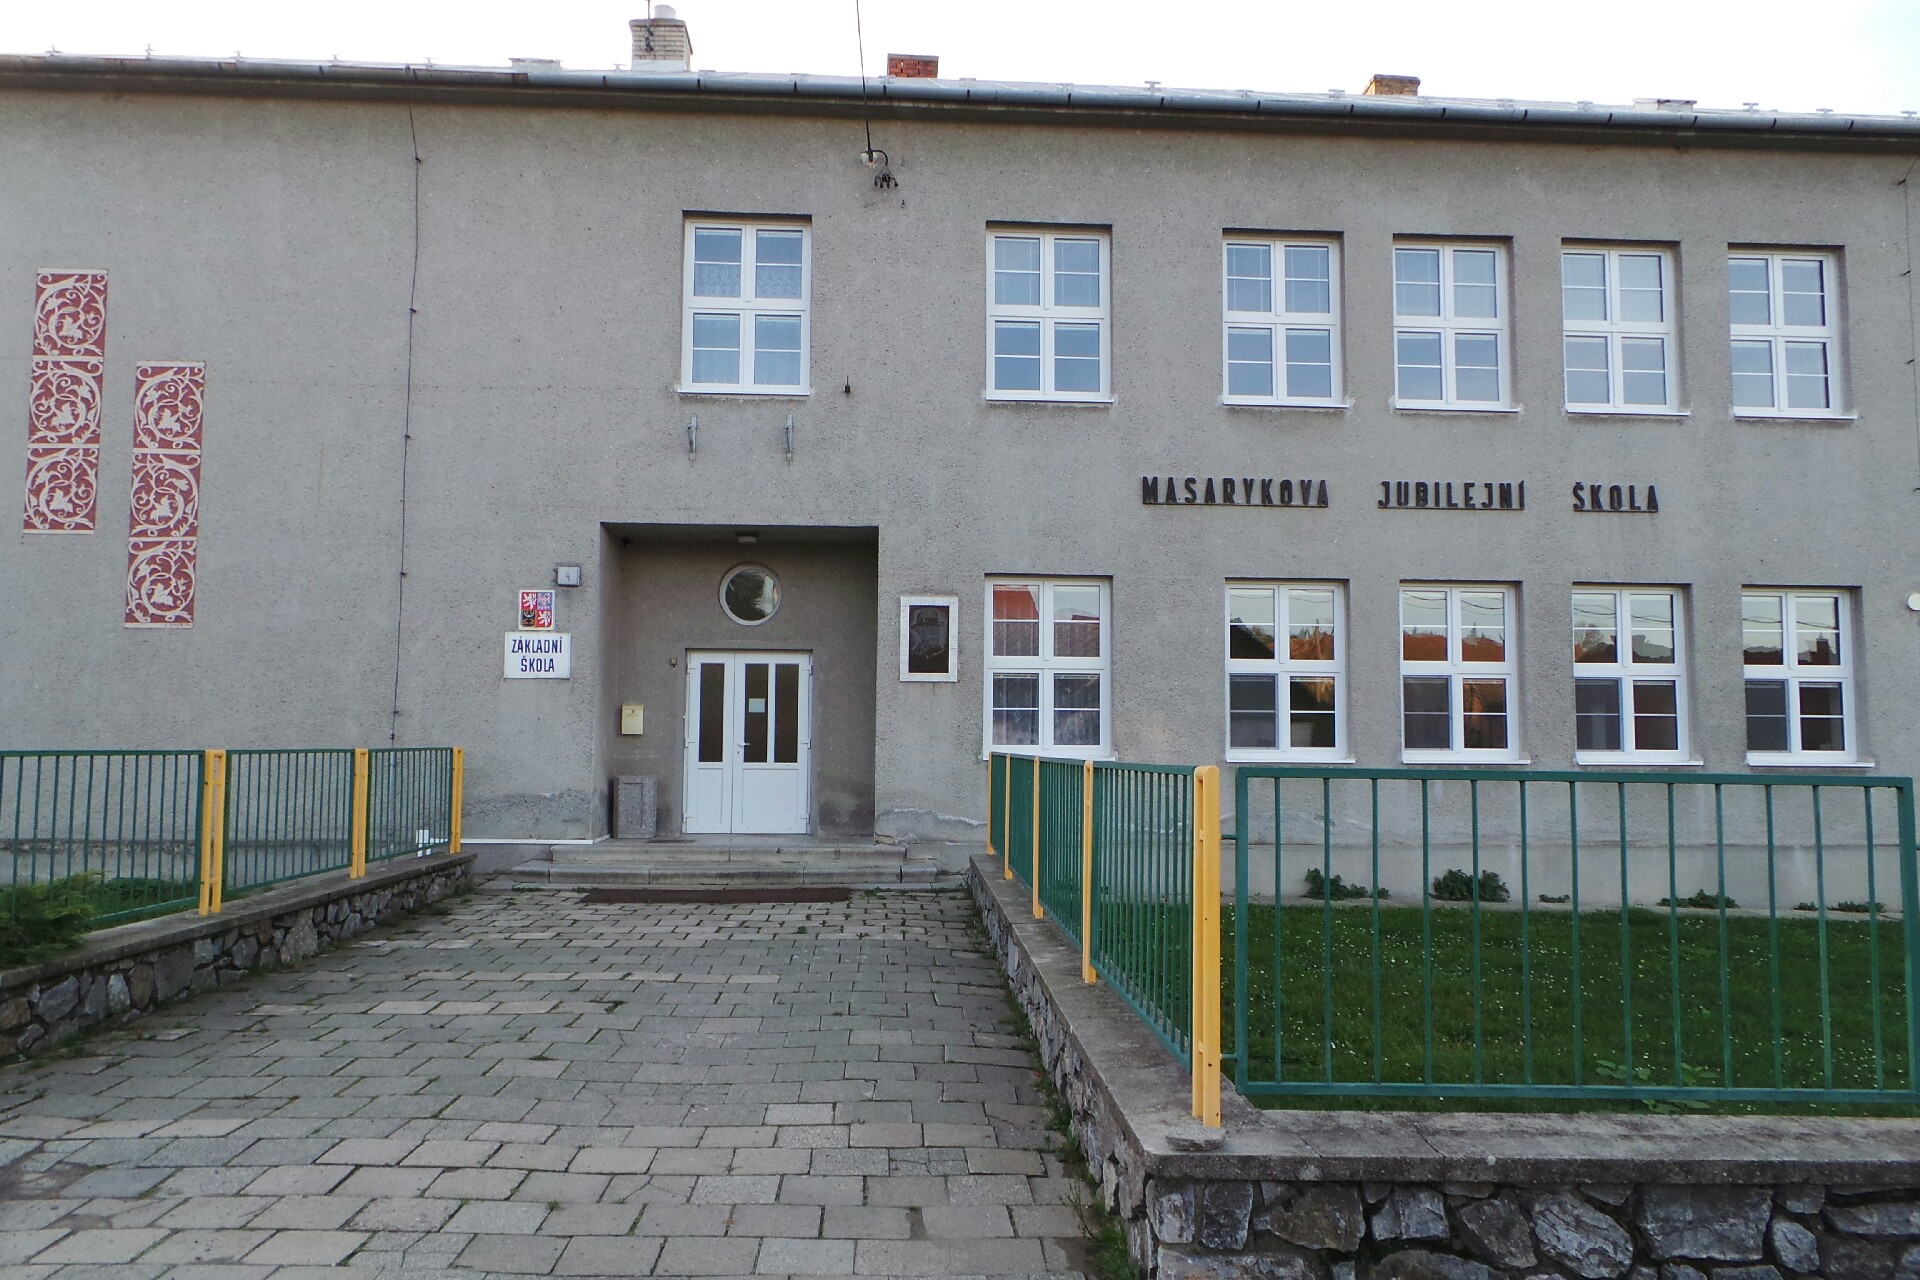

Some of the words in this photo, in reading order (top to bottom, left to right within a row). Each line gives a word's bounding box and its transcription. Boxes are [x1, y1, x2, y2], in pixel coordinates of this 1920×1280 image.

[1142, 476, 1329, 506] MASARYKOVA
[1378, 480, 1525, 509] JUBILEJNÍ
[1573, 481, 1659, 511] ŠKOLA
[511, 636, 563, 654] ZÁKLADNÍ
[520, 656, 555, 672] ŠKOLA
